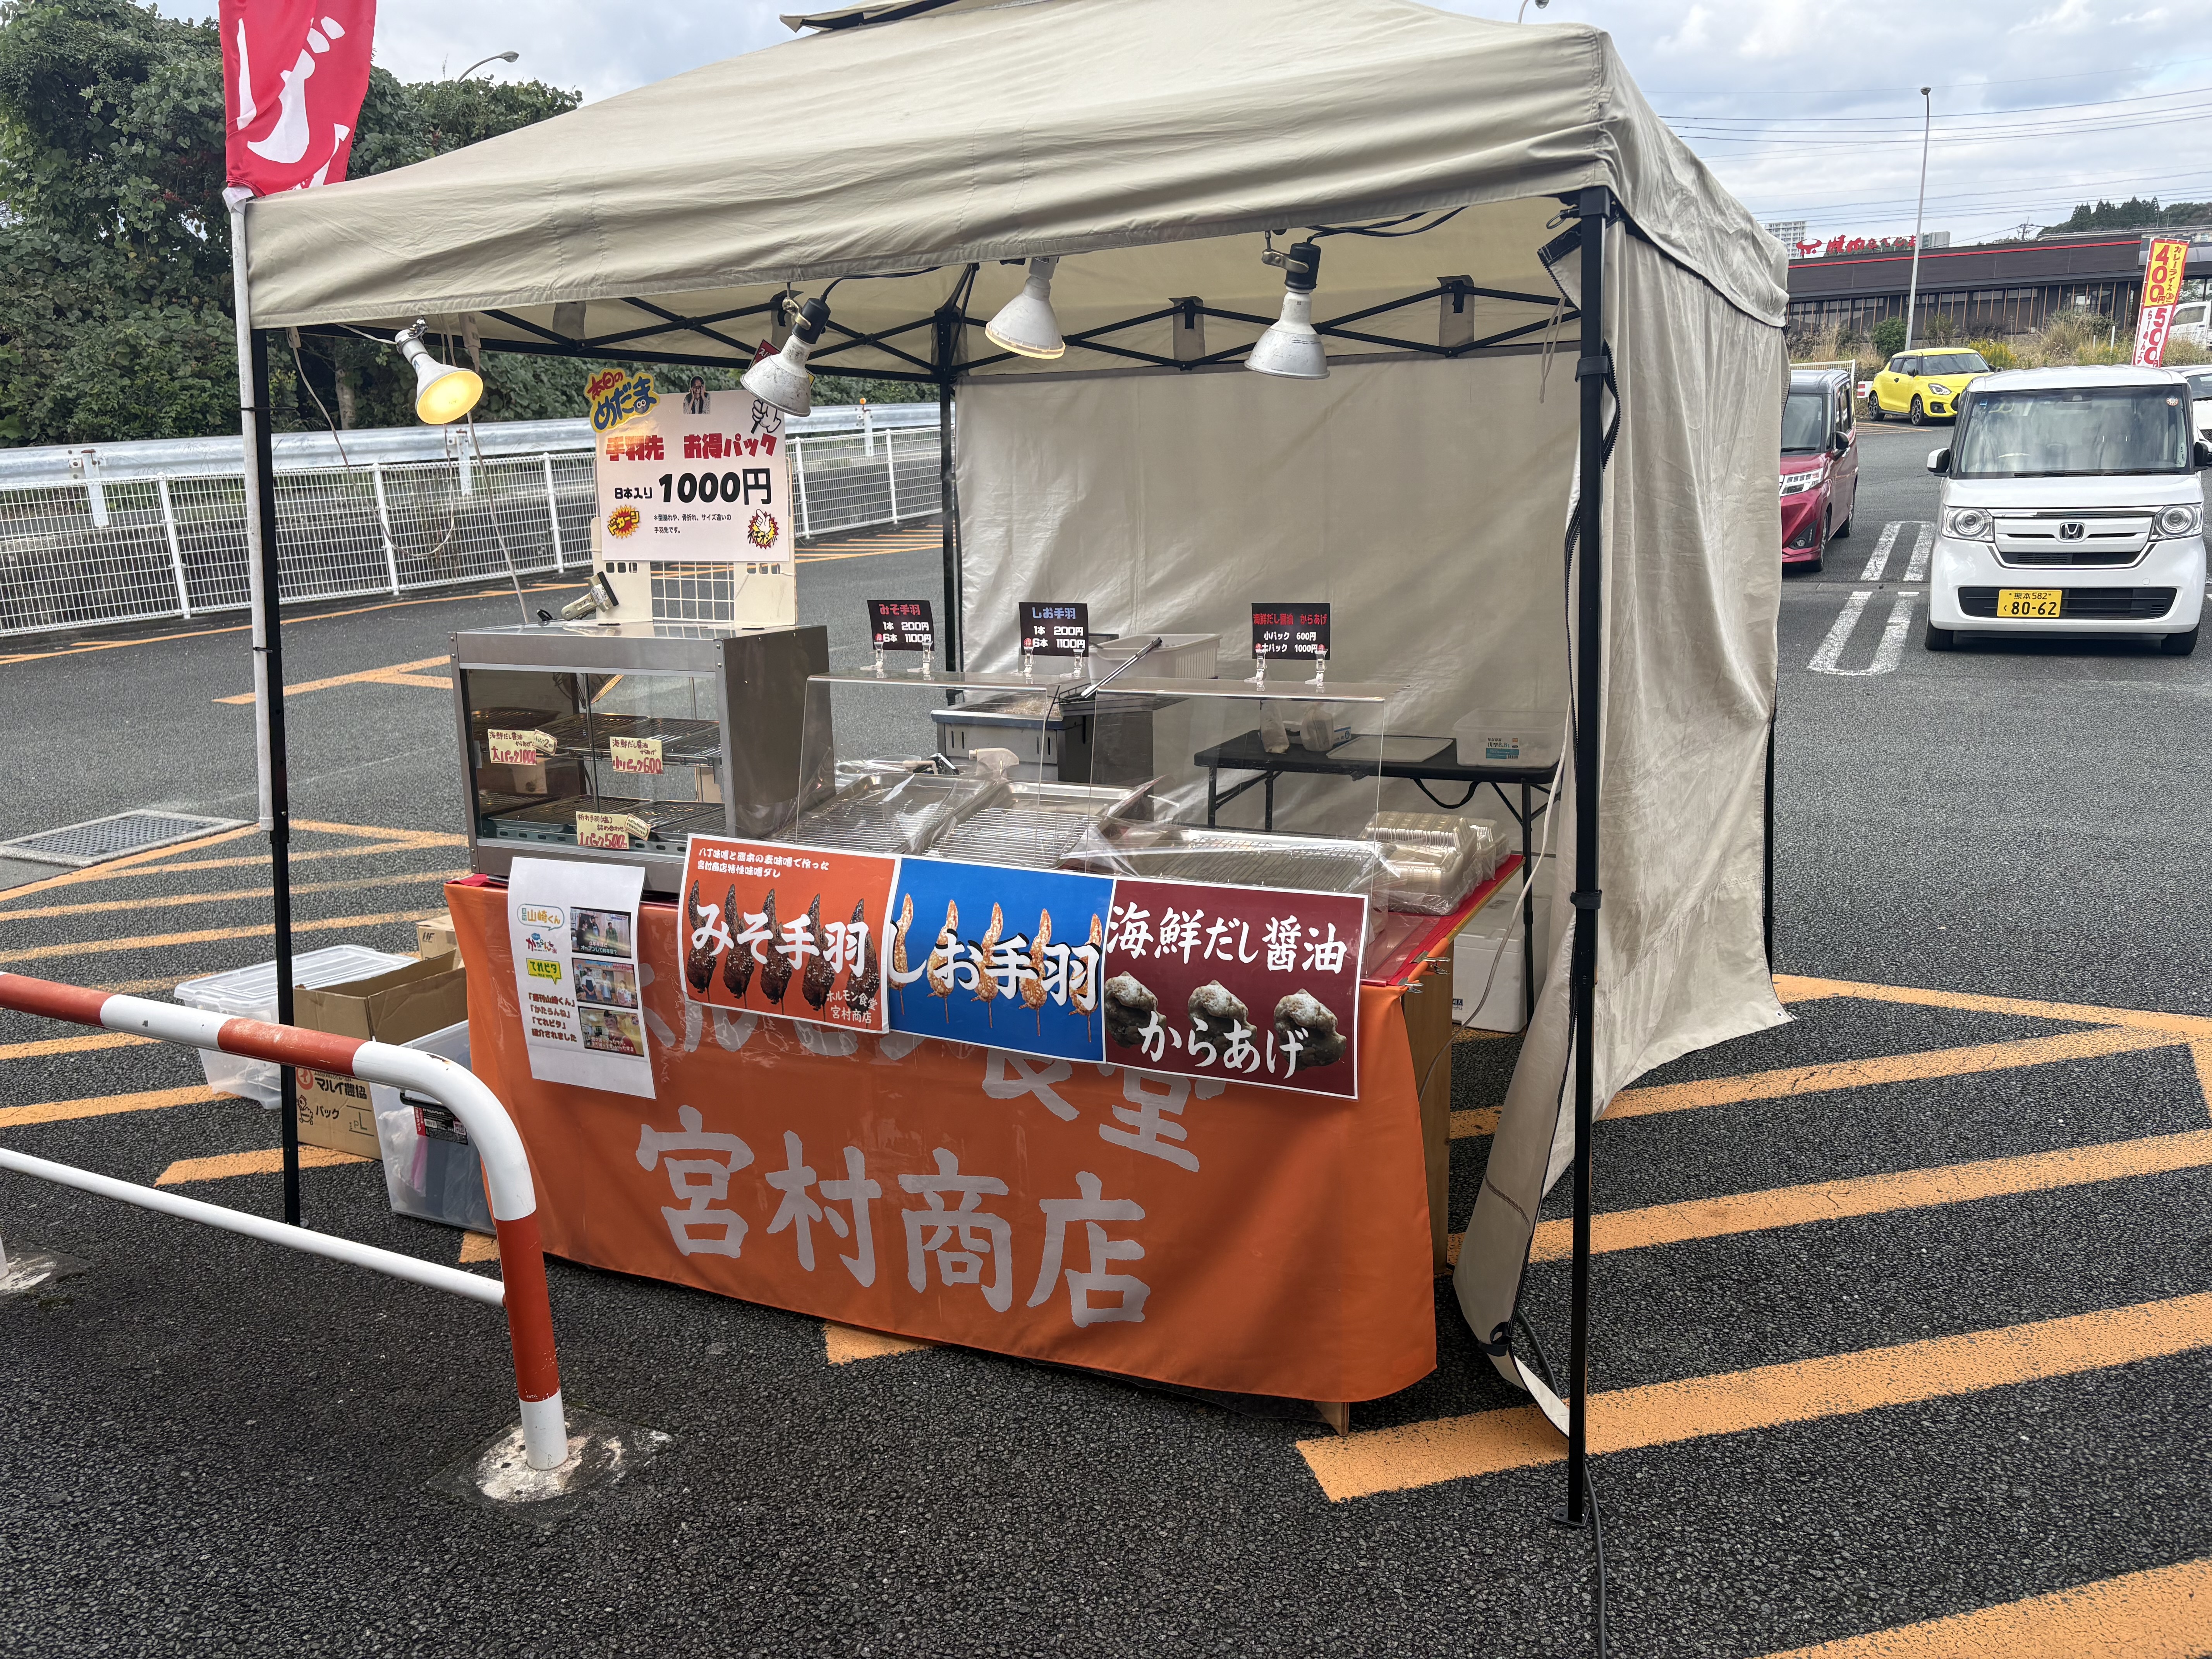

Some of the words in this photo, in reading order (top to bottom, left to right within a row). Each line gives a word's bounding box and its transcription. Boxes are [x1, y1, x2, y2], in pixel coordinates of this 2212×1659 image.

[2149, 245, 2170, 304] 400円
[2168, 246, 2182, 291] カレーライス
[587, 372, 623, 400] 本日の
[594, 376, 657, 430] めだま
[606, 434, 664, 461] 手羽先
[684, 433, 777, 459] お得パック
[658, 468, 772, 505] 1000円
[608, 511, 639, 536] ドカーン
[879, 604, 921, 615] みそ手羽
[1032, 607, 1076, 619] しお手羽
[2011, 601, 2057, 615] 80-62
[1253, 613, 1293, 625] 海鮮だし醤油
[1300, 613, 1328, 625] からあげ
[883, 622, 894, 630] 1本
[901, 622, 929, 631] 200円
[1034, 626, 1045, 635] 1本
[1054, 626, 1084, 636] 200円
[883, 634, 897, 642] 6本
[905, 634, 931, 642] 1100円
[1032, 638, 1048, 647] 6本
[1056, 639, 1085, 648] 1100円
[1264, 631, 1290, 640] 小パック
[1297, 632, 1316, 641] 600円
[1262, 643, 1288, 653] 大パック
[1294, 644, 1318, 653] 1000円
[489, 731, 523, 740] 海鮮だし醤油
[612, 738, 648, 749] 海鮮だし醤油
[597, 824, 625, 832] 詰め合わせ
[691, 903, 869, 977] みそ手羽
[1107, 902, 1347, 974] 海鮮だし醤油
[530, 961, 557, 974] てれビタ
[888, 920, 1103, 1010] しお手羽
[826, 990, 878, 1011] ホルモン食堂
[831, 1005, 872, 1024] 宮村商店
[532, 1017, 566, 1030] 「てれビタ」
[532, 1028, 577, 1042] 紹介されました
[1138, 1011, 1309, 1079] からあげ
[315, 1077, 367, 1099] マルイ農協
[635, 1104, 1151, 1328] 宮村商店
